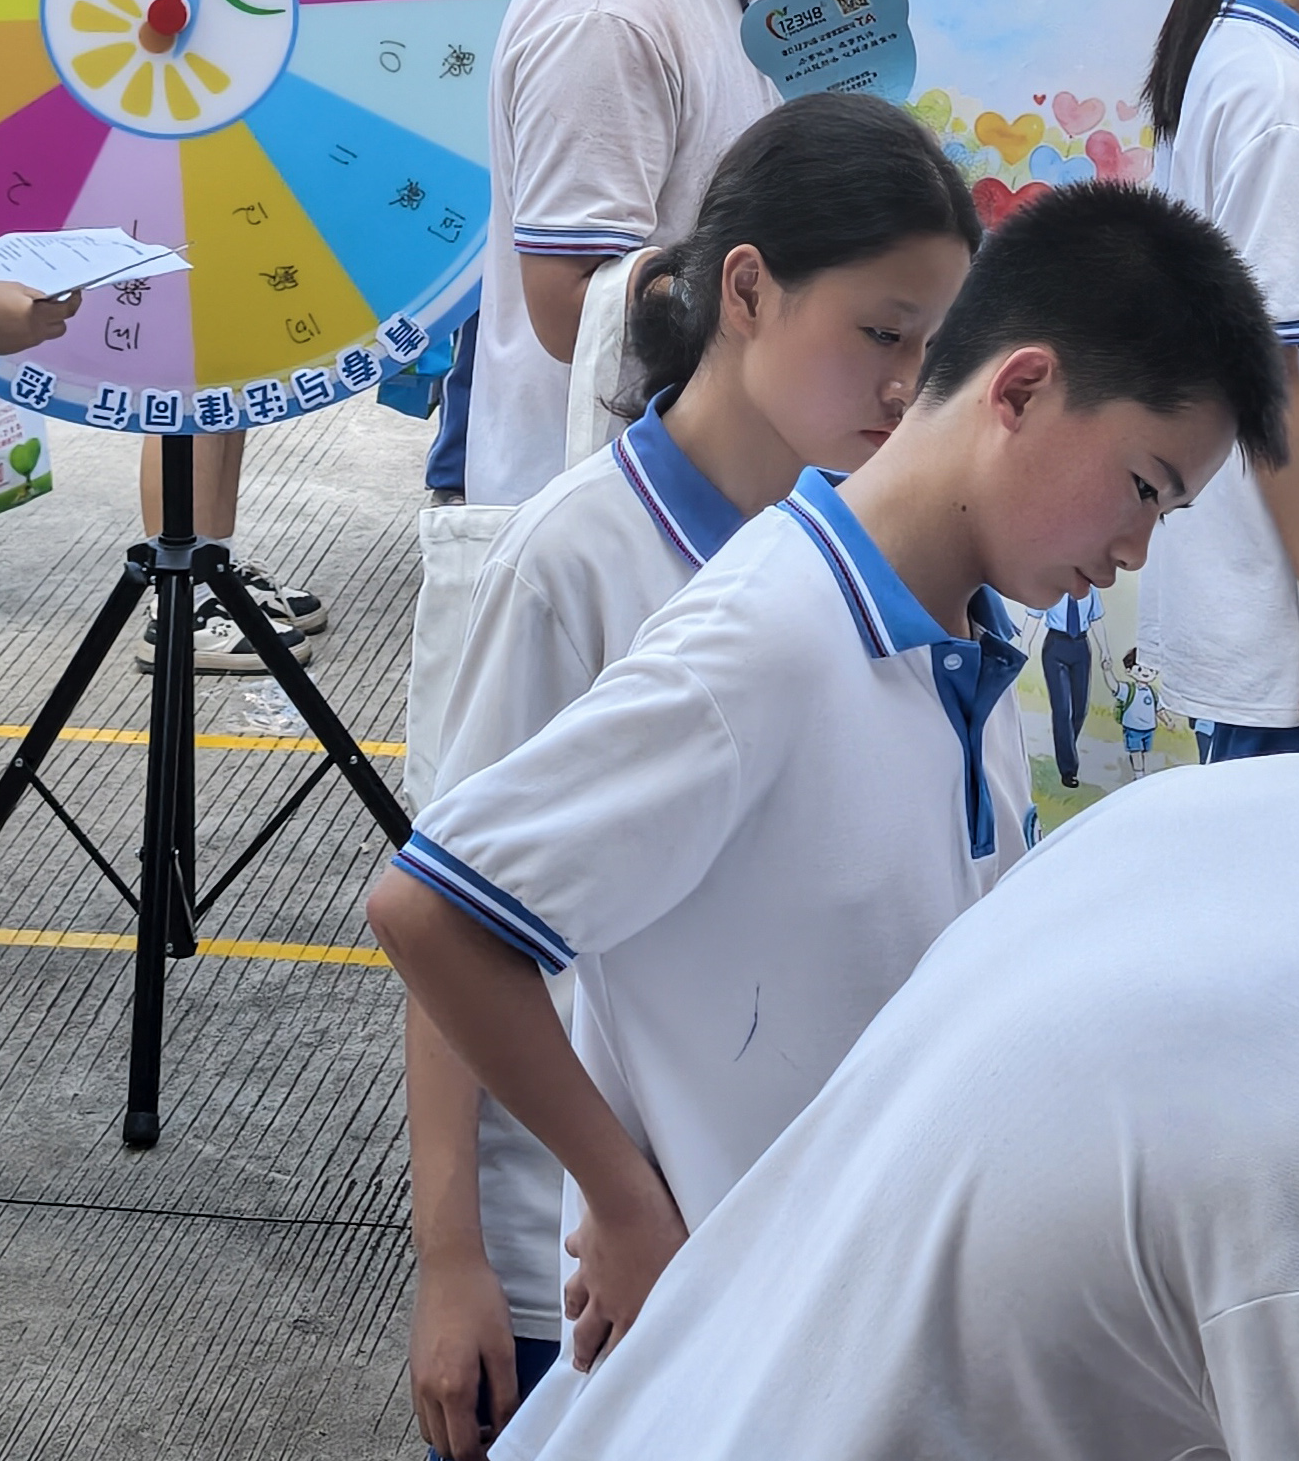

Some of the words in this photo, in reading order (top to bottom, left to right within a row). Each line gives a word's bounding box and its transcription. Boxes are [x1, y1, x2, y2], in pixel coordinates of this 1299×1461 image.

[778, 6, 823, 33] 12348
[93, 316, 425, 428] 青春与法律同行
